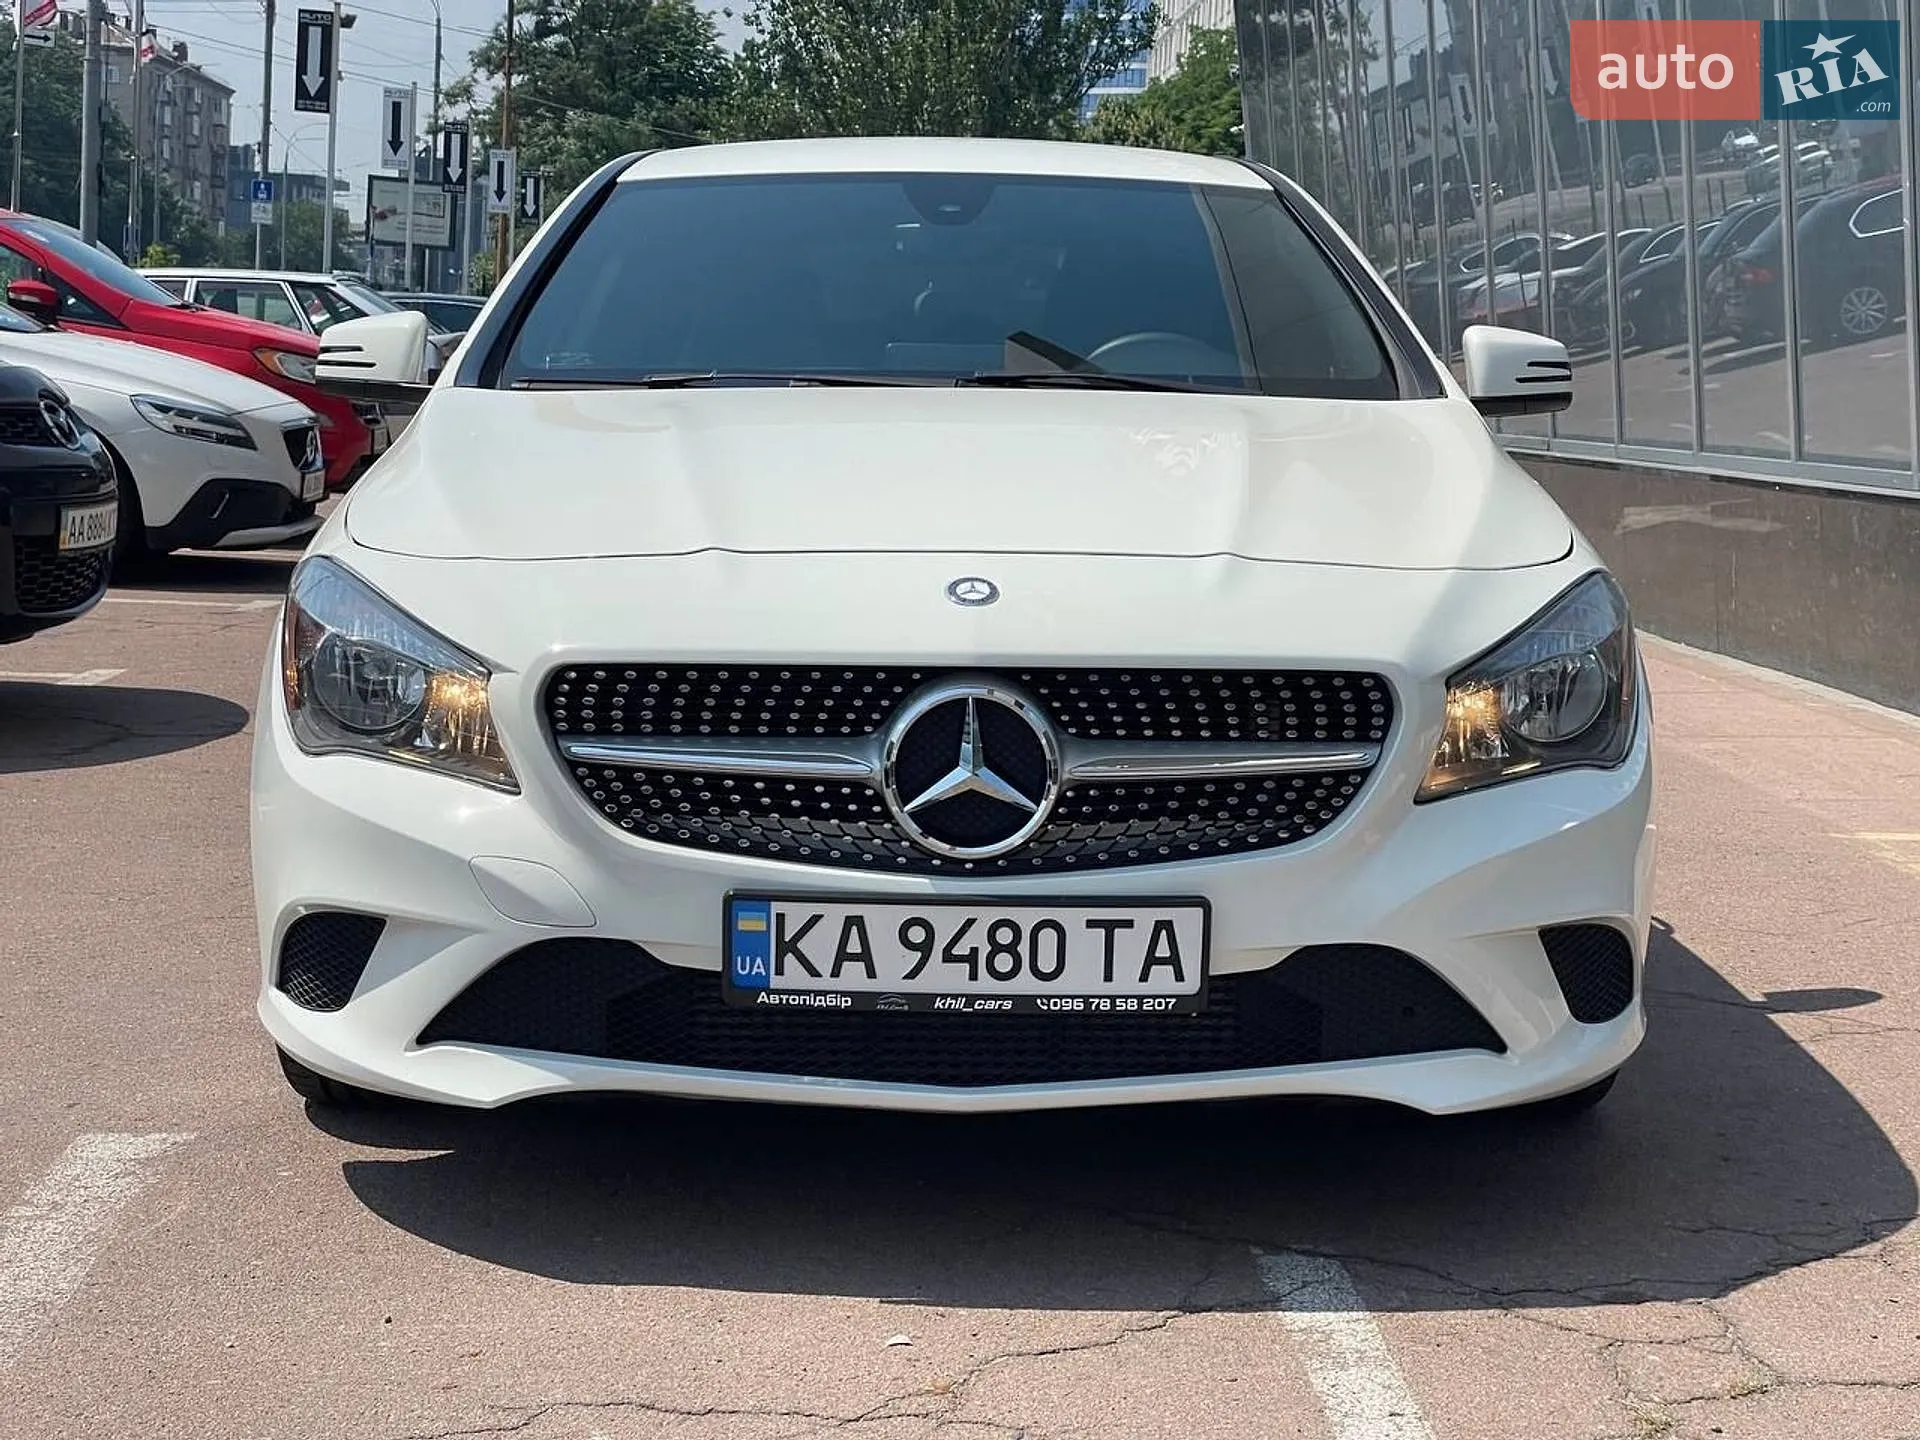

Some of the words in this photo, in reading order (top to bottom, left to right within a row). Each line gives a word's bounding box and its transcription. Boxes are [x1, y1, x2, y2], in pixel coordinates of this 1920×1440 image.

[67, 516, 85, 544] AA
[775, 912, 877, 979] KA
[898, 916, 1067, 982] 9480
[1086, 919, 1185, 983] TA
[736, 956, 766, 976] UA
[757, 991, 852, 1009] Автопідбір
[934, 996, 1013, 1012] khil_cars
[1050, 998, 1085, 1011] 096
[1089, 998, 1111, 1011] 78
[1115, 998, 1138, 1011] 58
[1142, 998, 1177, 1011] 207
